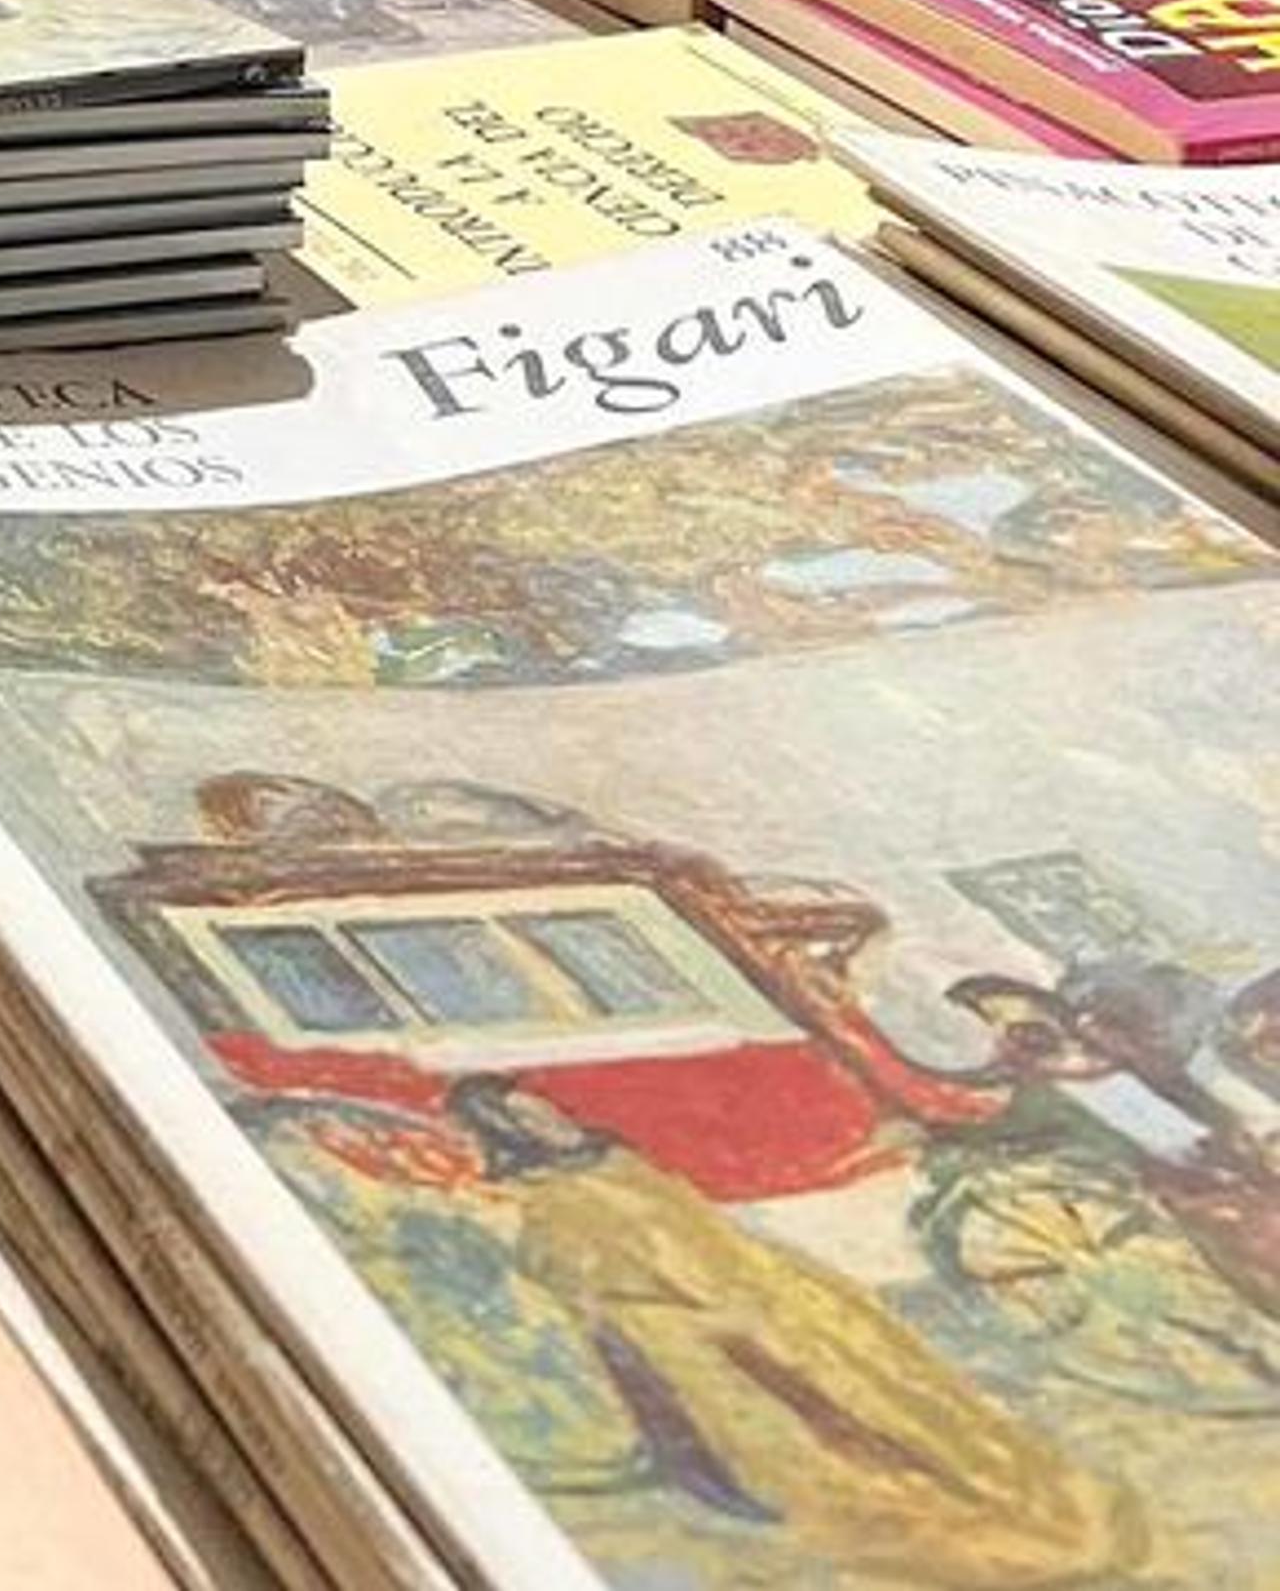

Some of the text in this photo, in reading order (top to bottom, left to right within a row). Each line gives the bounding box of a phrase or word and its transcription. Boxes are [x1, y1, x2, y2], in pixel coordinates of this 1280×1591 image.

[443, 99, 684, 239] CIENCIA DEL
[533, 104, 727, 211] DERECHO
[379, 254, 865, 421] Figari
[60, 417, 203, 451] LOS
